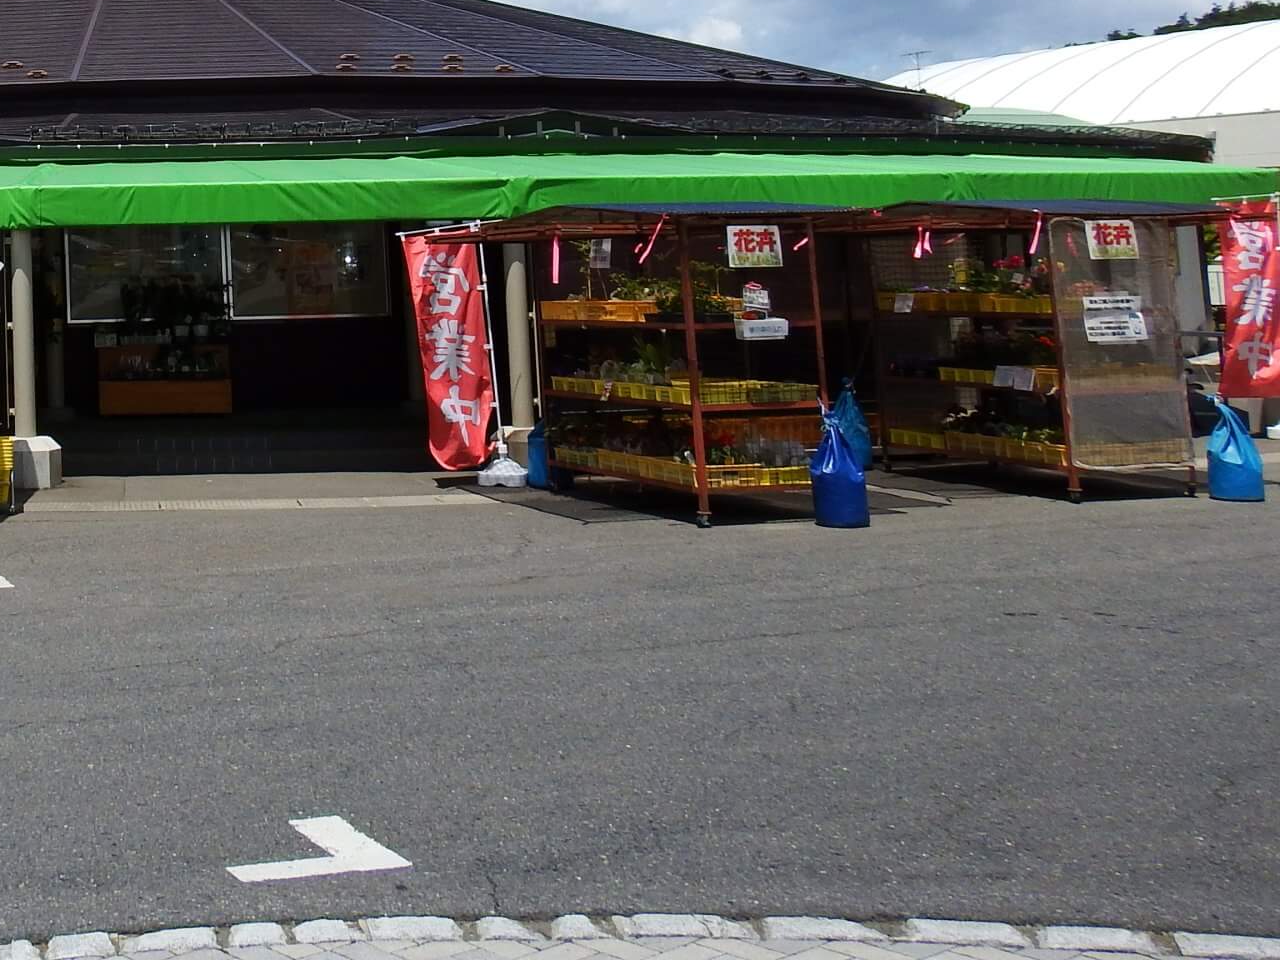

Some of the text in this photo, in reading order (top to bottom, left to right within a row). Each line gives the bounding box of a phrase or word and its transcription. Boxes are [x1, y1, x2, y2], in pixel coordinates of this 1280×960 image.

[734, 229, 776, 252] 花卉
[1091, 223, 1132, 245] 花卉
[1227, 221, 1273, 380] 営業中
[419, 251, 481, 448] 営業中
